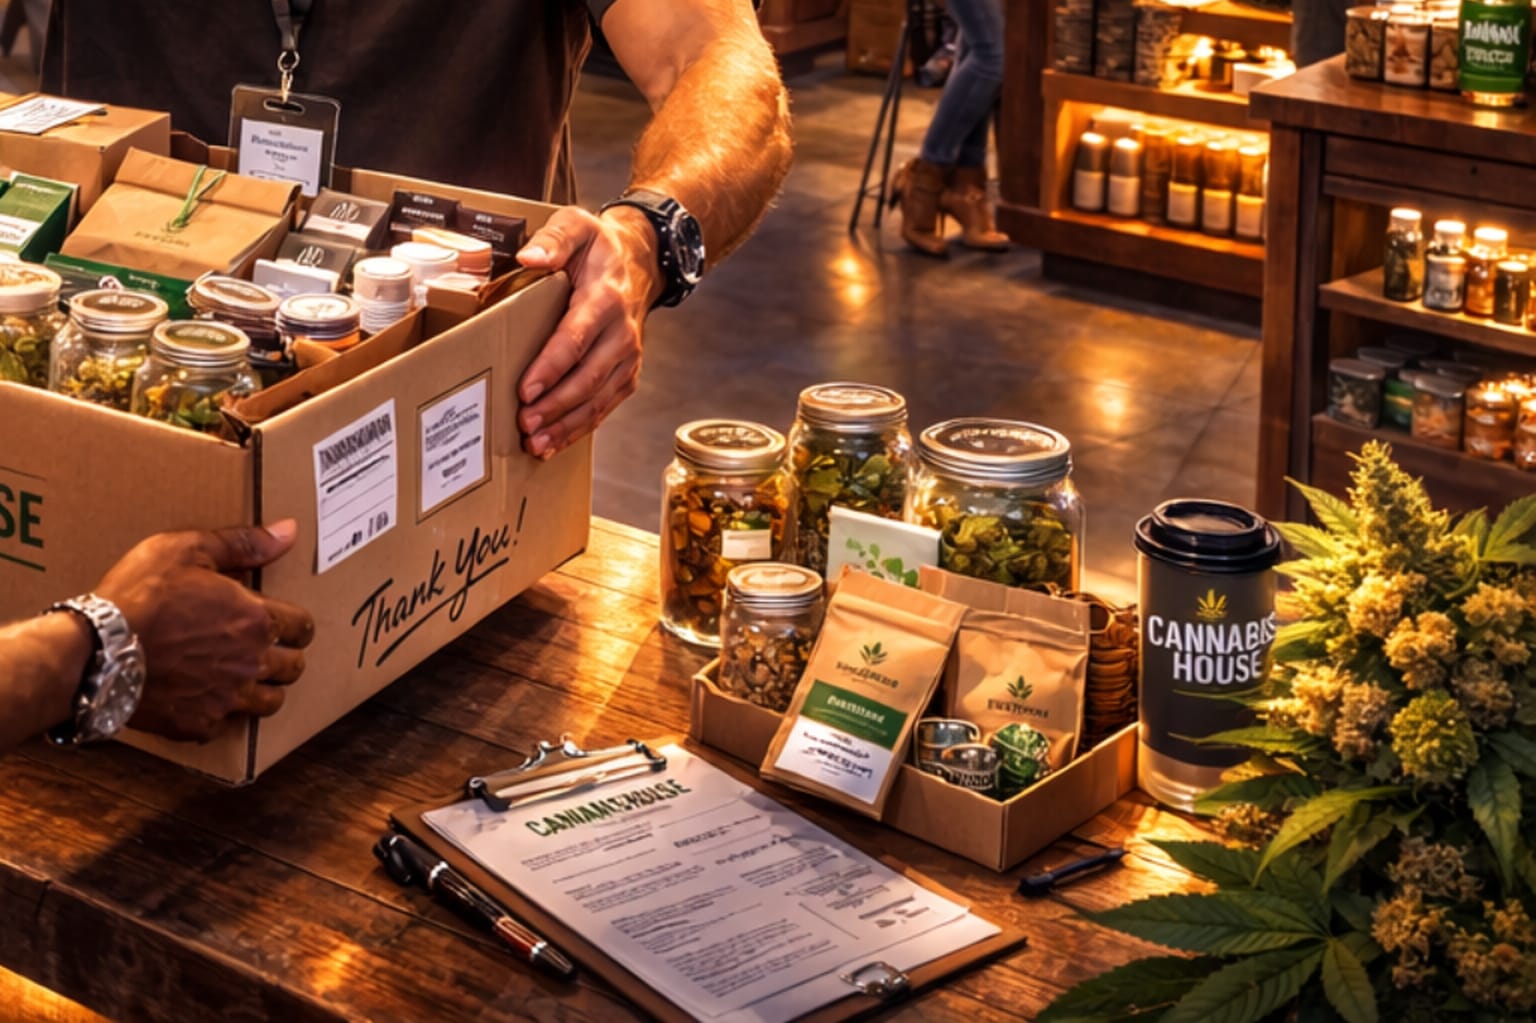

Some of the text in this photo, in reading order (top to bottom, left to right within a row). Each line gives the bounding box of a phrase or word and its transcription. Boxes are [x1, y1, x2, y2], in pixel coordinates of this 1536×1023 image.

[351, 496, 527, 669] Thank You!
[1147, 611, 1277, 655] CANNABIS
[1172, 650, 1263, 685] HOUSE
